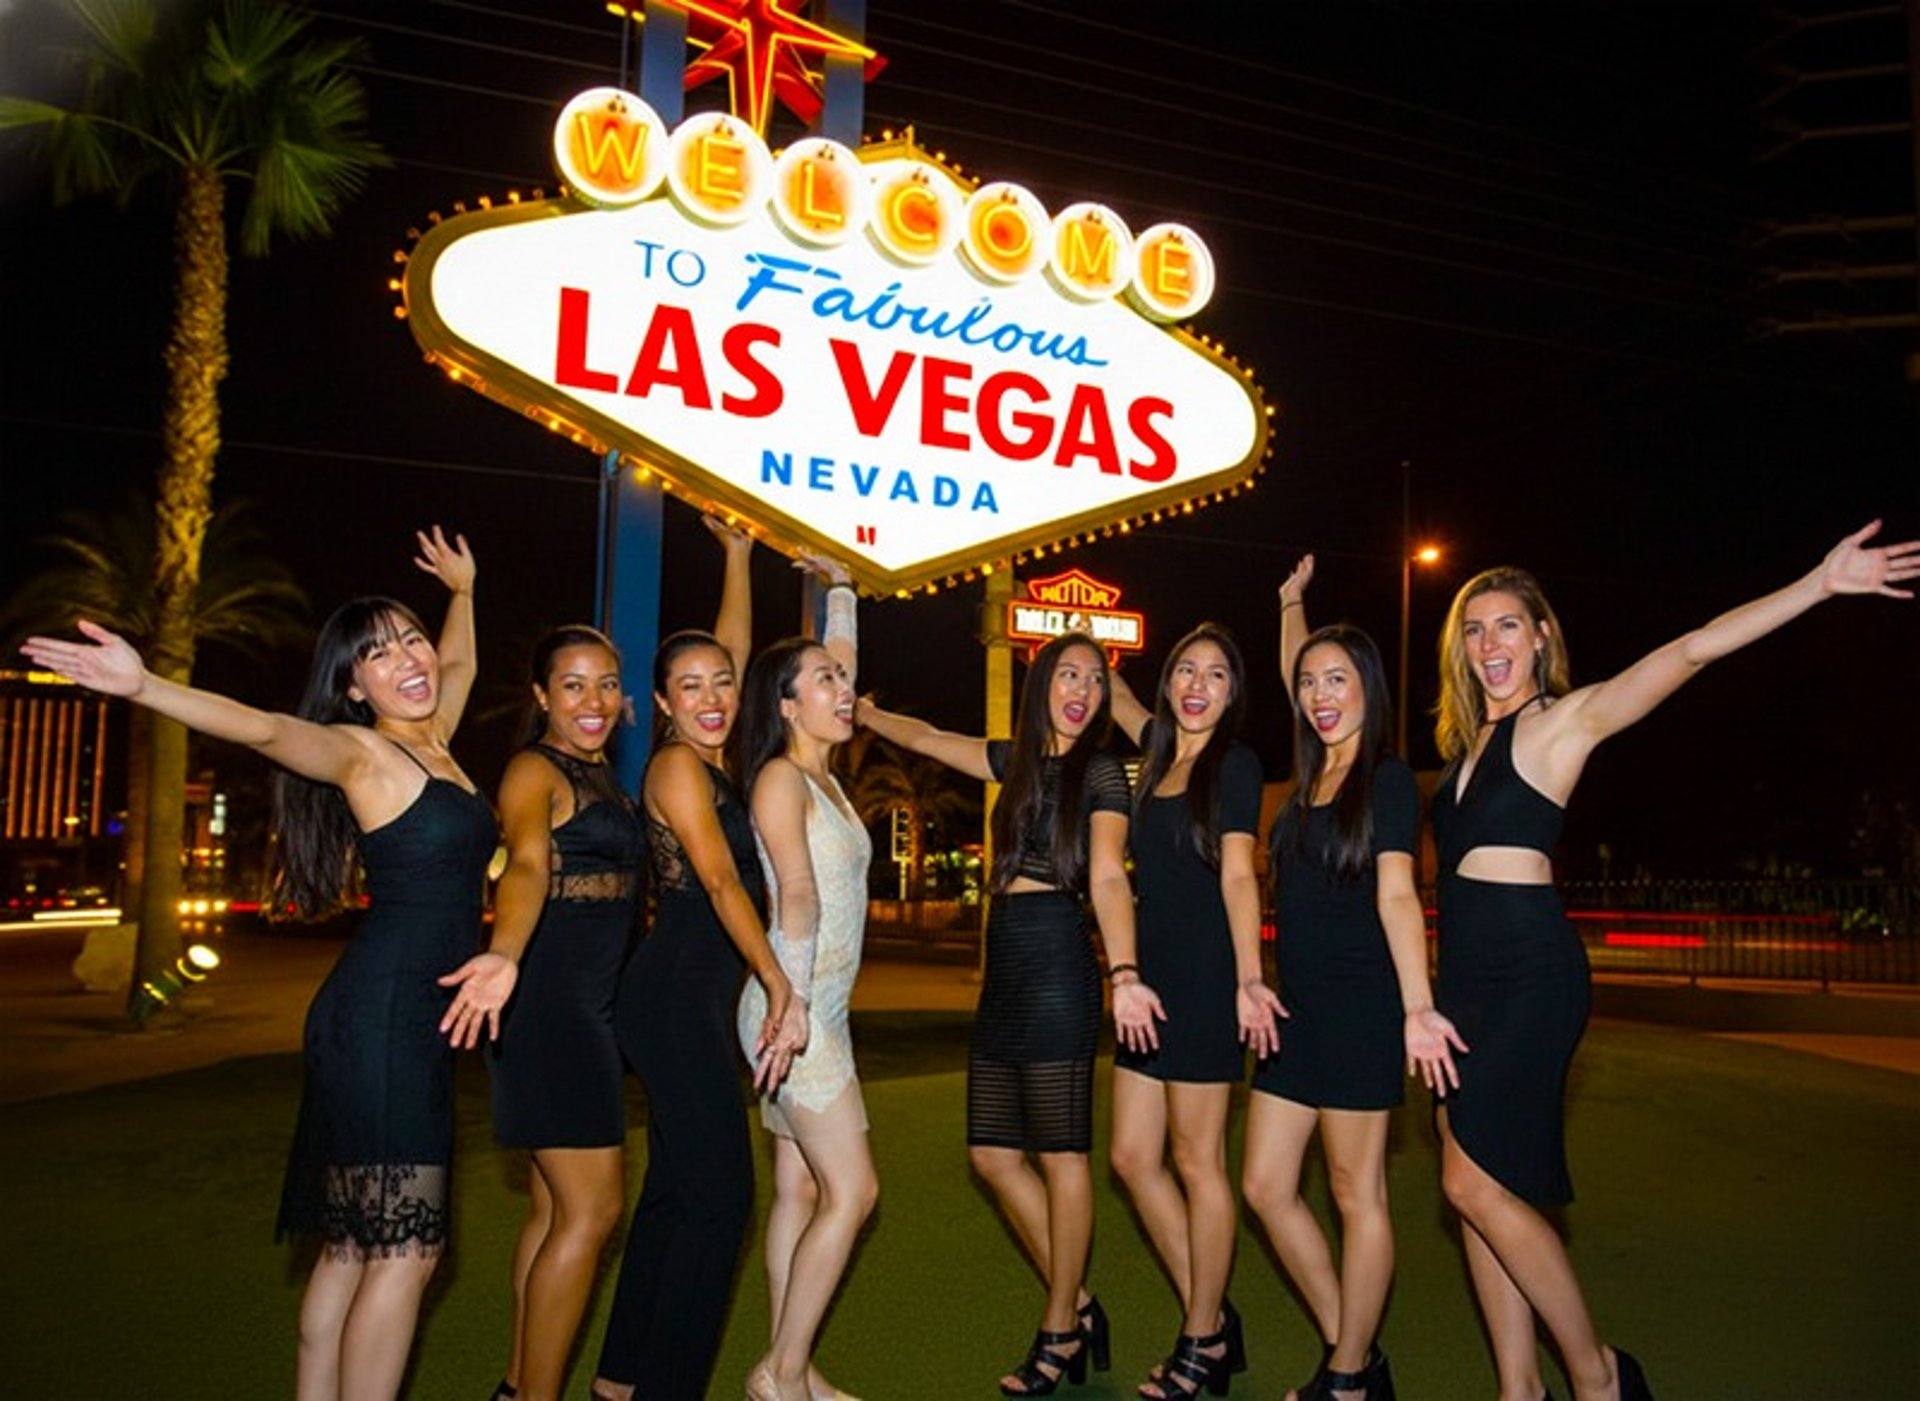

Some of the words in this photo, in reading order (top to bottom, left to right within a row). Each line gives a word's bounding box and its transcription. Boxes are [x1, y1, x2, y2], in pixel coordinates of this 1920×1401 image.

[575, 112, 1192, 300] WELCOME
[634, 239, 708, 290] TO
[735, 252, 1109, 369] Fabulous
[554, 287, 785, 419] LAS
[829, 339, 1179, 484] VEGAS
[760, 448, 1001, 515] NEVADA
